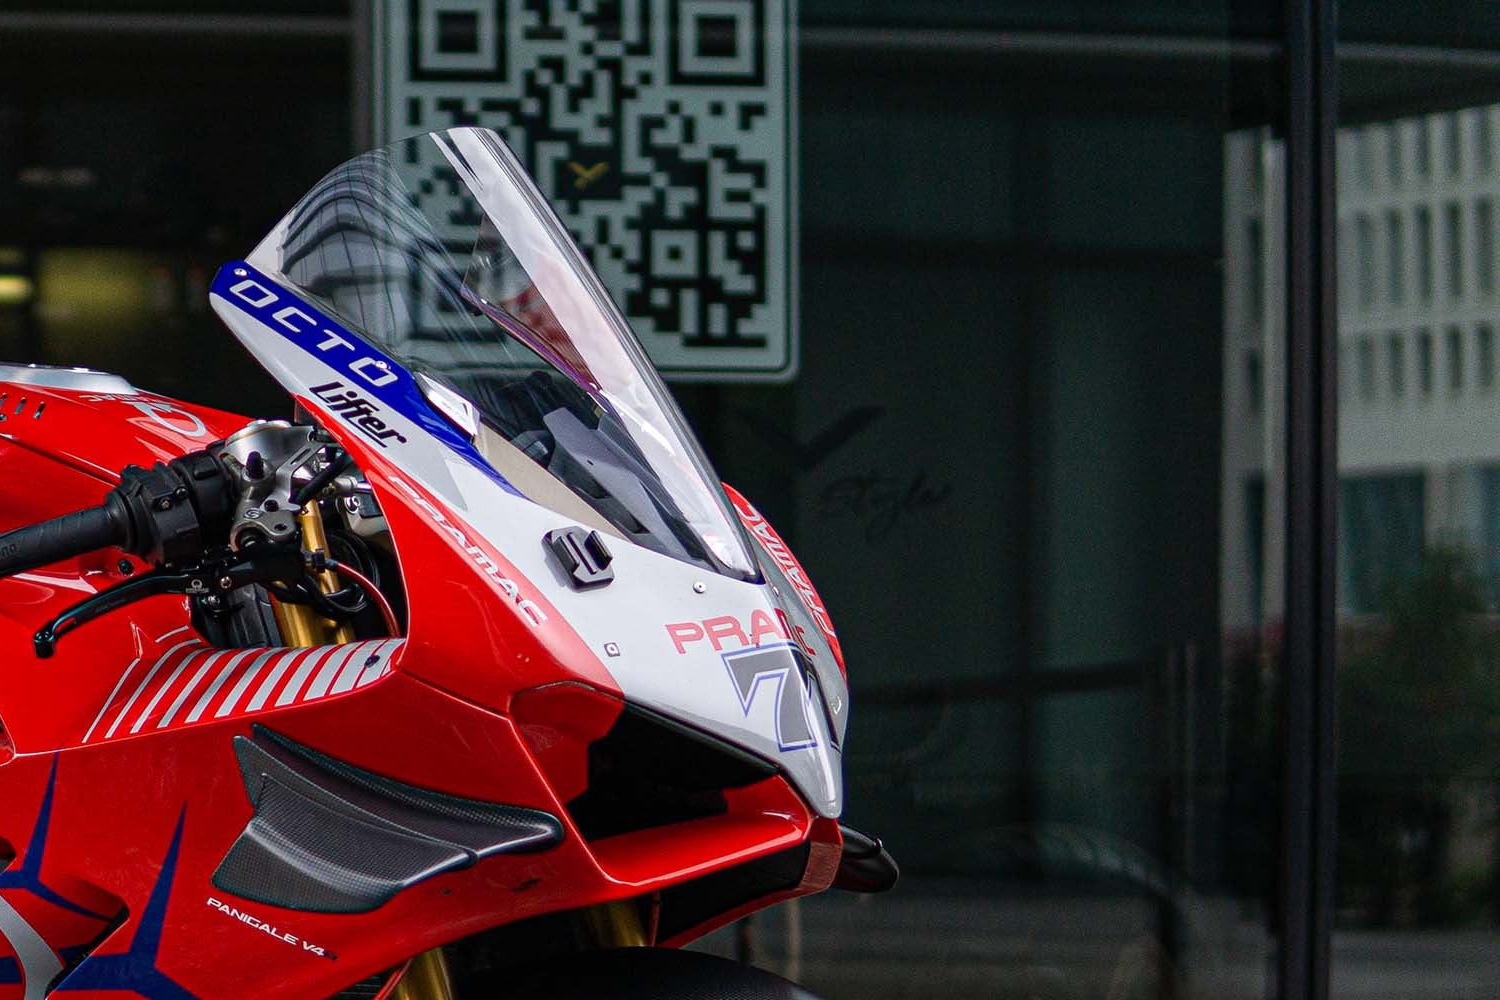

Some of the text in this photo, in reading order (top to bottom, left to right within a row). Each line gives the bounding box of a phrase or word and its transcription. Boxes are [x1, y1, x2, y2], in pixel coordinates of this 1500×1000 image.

[229, 279, 398, 387] OCTO
[388, 475, 548, 627] PRAMAC
[733, 503, 836, 639] PRAMAC
[206, 897, 299, 946] PANIGALE
